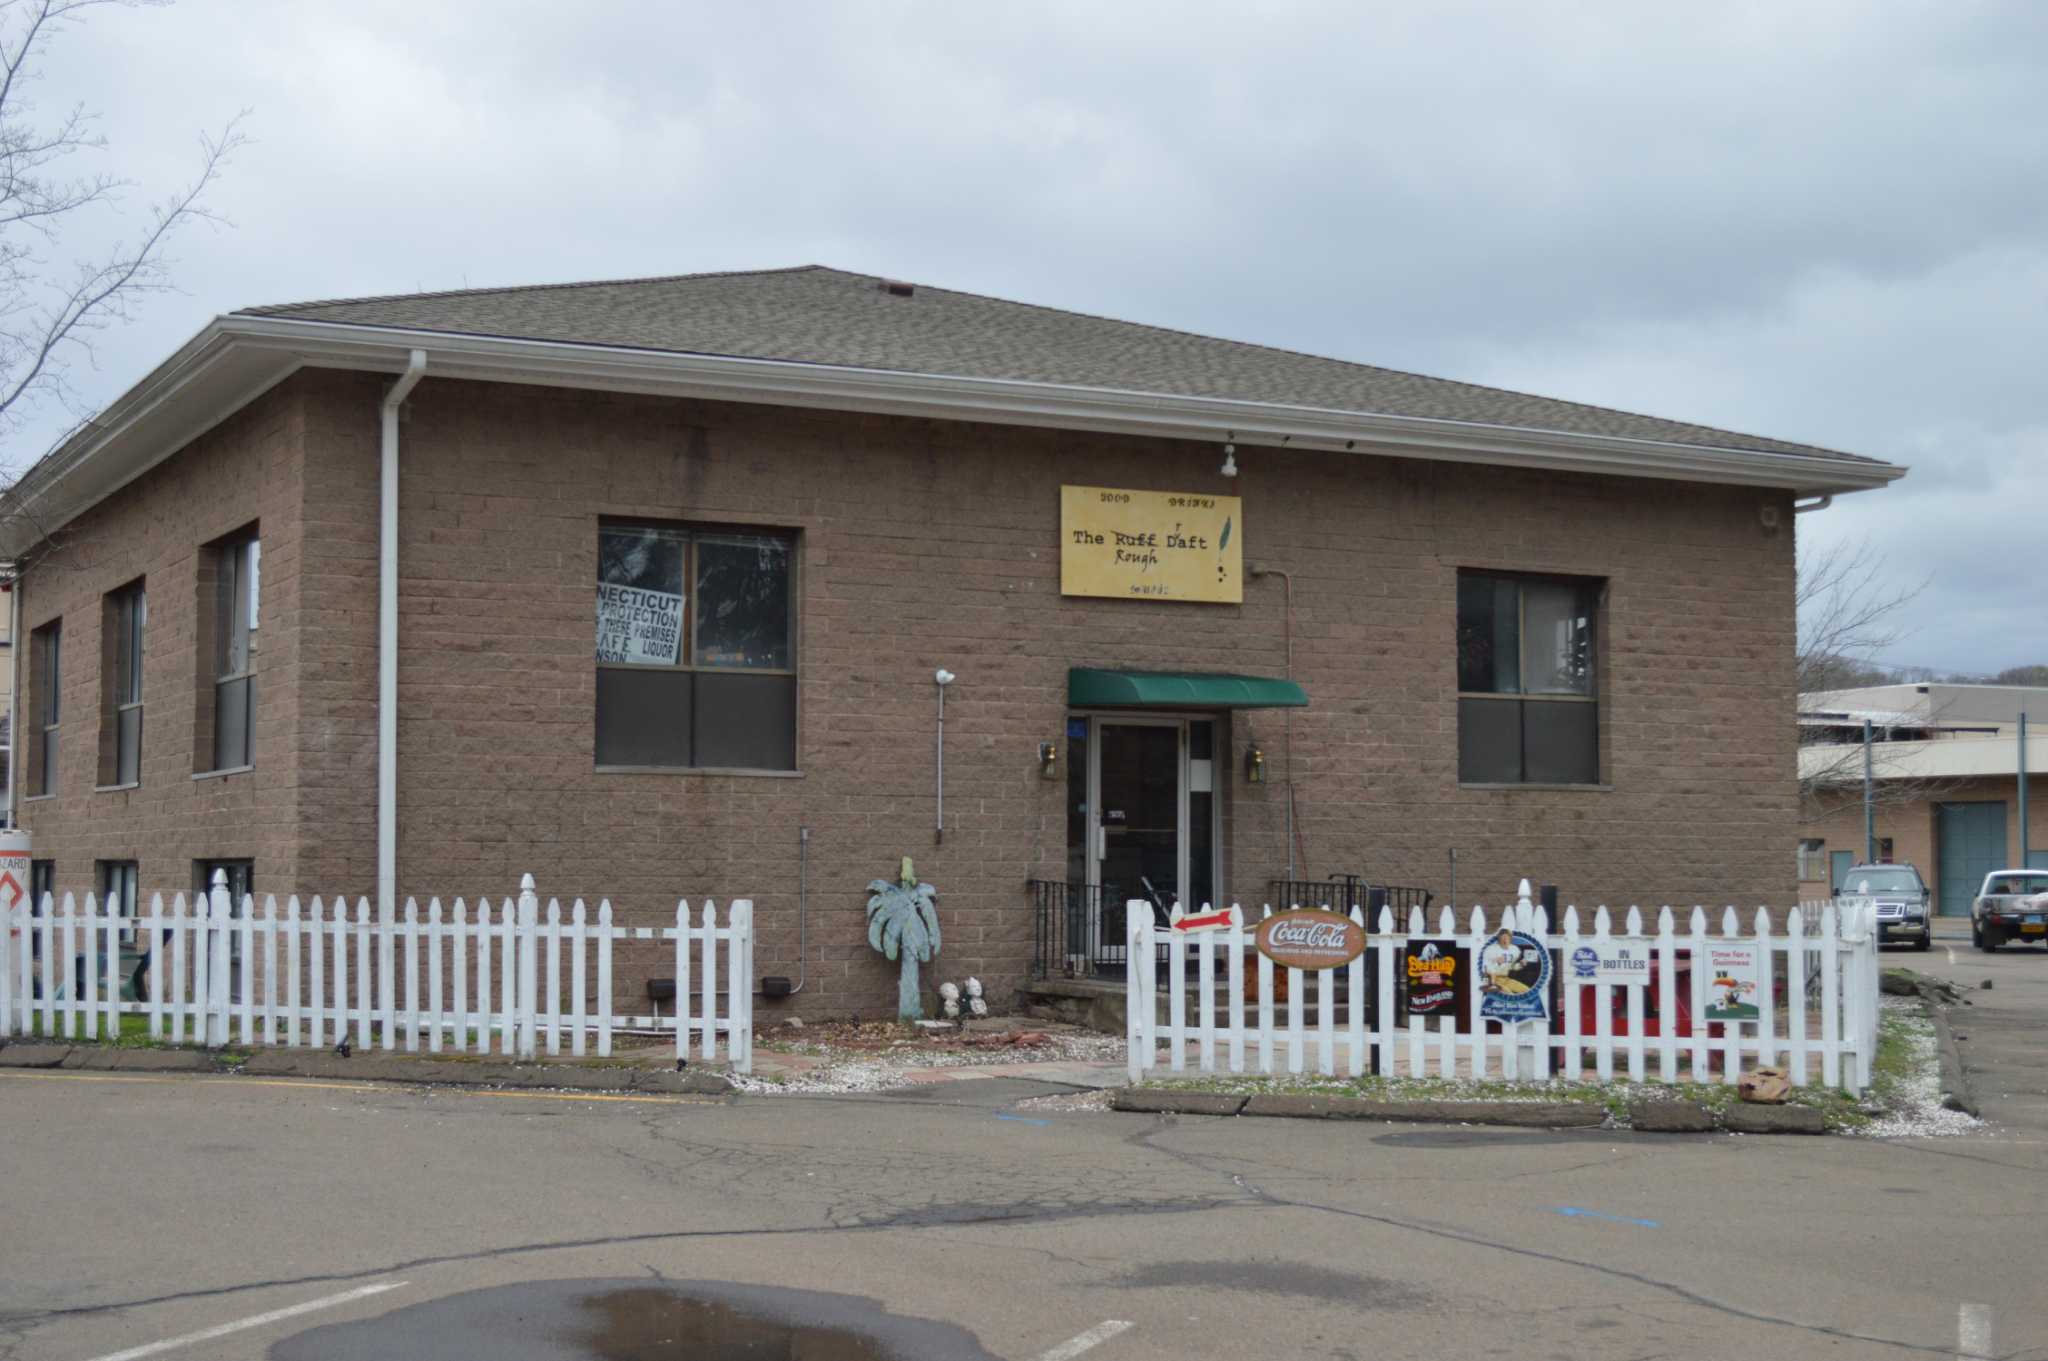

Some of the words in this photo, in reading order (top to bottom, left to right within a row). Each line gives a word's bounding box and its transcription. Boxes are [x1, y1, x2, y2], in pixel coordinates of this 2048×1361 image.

[1073, 530, 1105, 545] The
[1114, 549, 1158, 573] Rough
[597, 585, 681, 613] NECTICUT
[601, 601, 679, 629] PROTECTION
[634, 622, 677, 644] PREMISES
[596, 632, 632, 653] AFE
[642, 639, 674, 660] LIQUOR
[0, 858, 25, 870] ZARD
[1268, 920, 1349, 948] Coca-Cola
[1603, 960, 1646, 969] BOTTLES
[1618, 949, 1630, 959] IN
